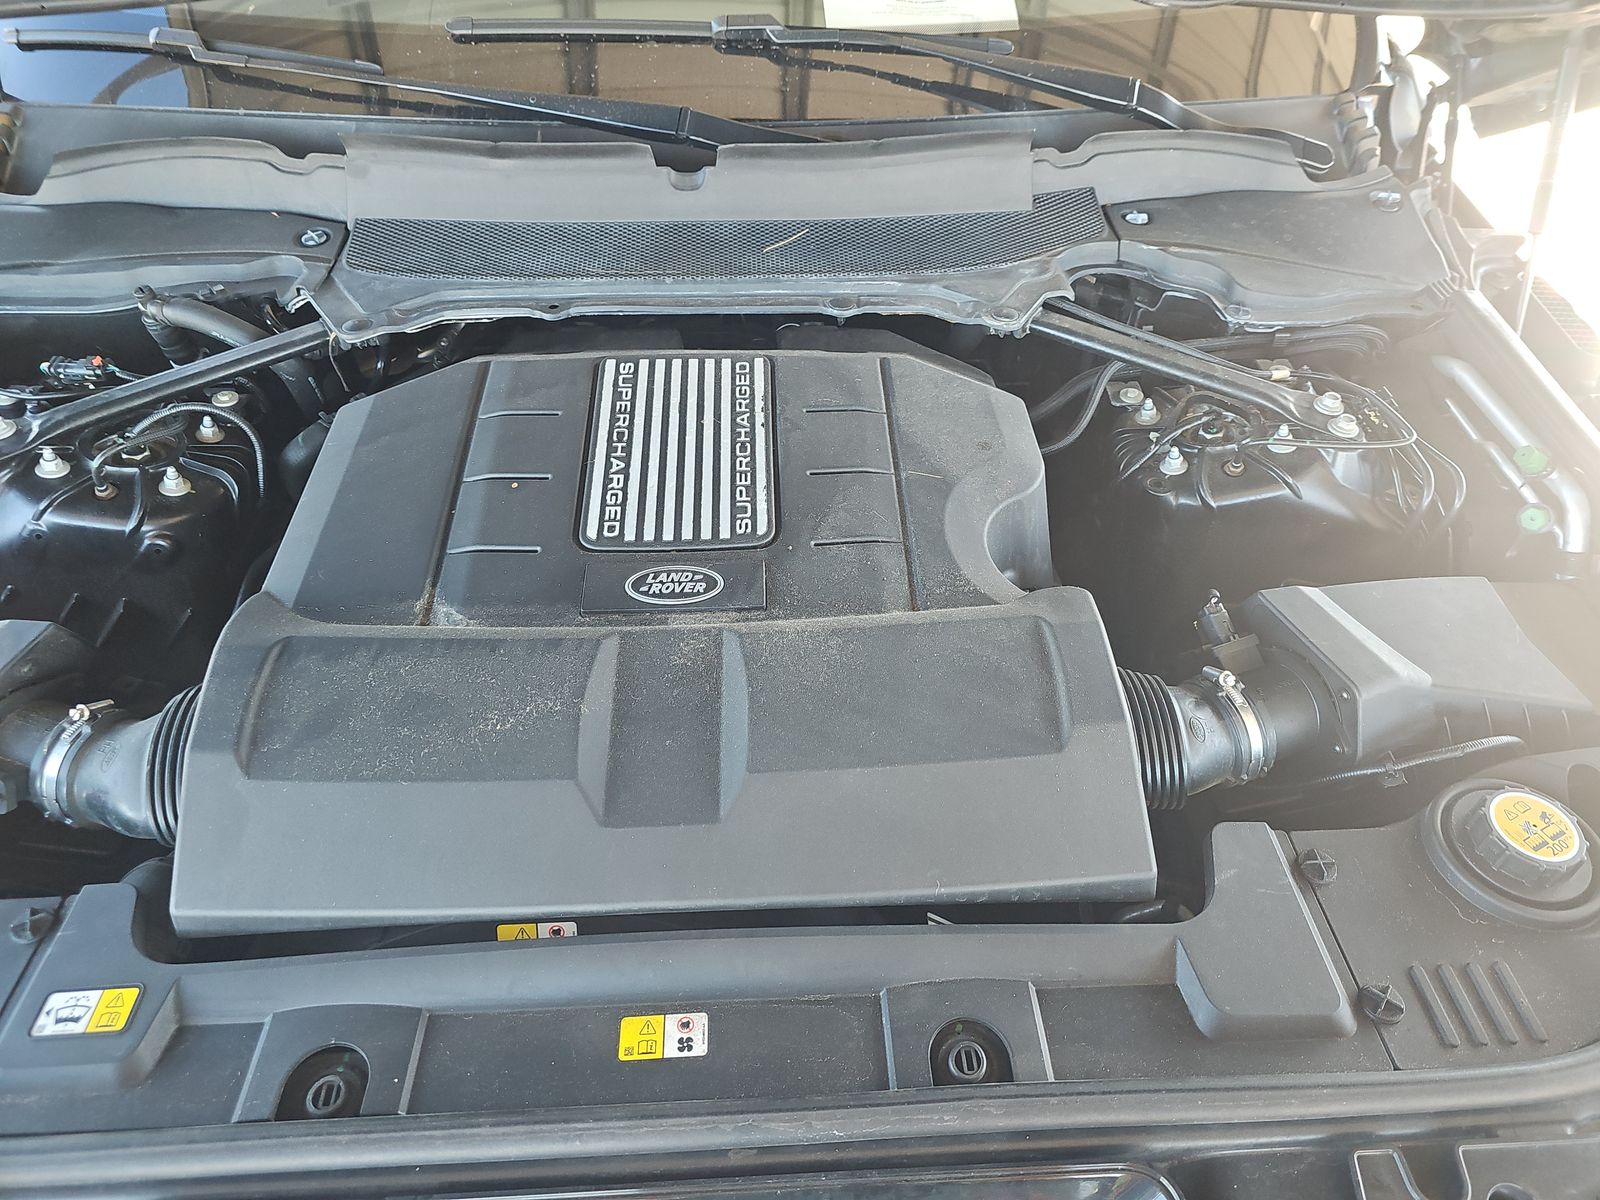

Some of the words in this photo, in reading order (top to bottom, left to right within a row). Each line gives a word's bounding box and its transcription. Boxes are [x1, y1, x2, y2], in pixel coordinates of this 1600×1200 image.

[602, 361, 635, 538] SUPERCHARGED
[735, 361, 752, 535] SUPERCHARGED
[645, 572, 695, 584] LAND
[647, 582, 707, 595] ROVER
[1546, 839, 1569, 856] 200
